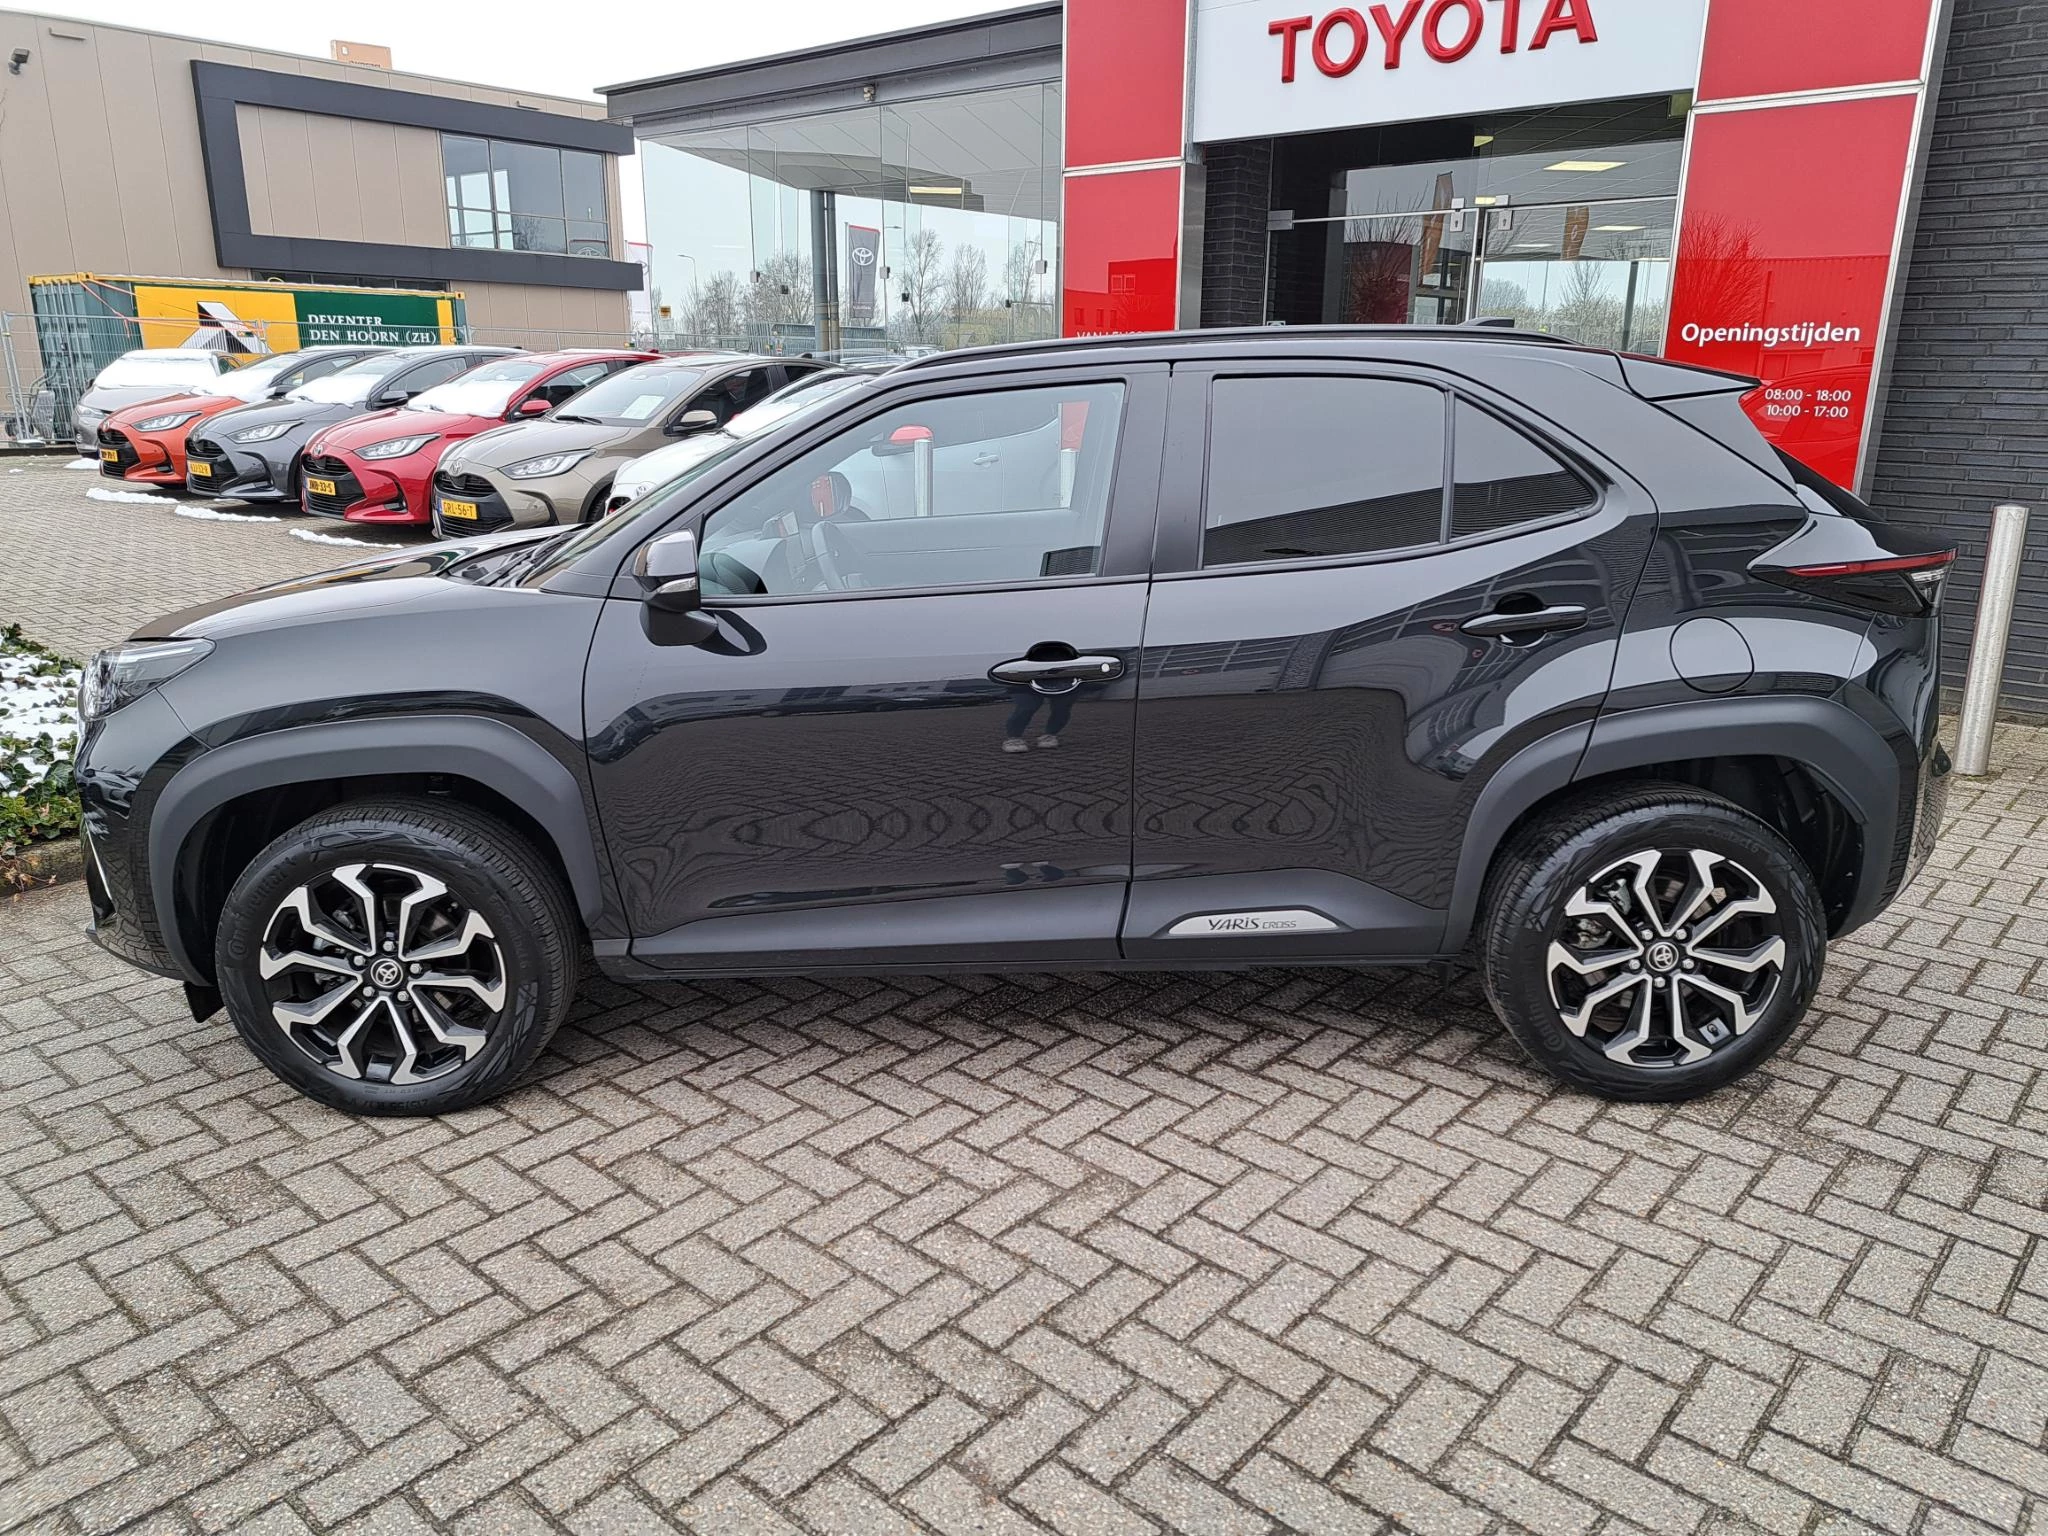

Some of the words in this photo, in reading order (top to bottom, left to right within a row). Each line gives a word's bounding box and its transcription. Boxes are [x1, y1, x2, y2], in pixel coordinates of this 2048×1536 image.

[1268, 0, 1598, 83] TOYOTA
[307, 314, 382, 326] DEVENTER
[309, 330, 340, 341] DEN
[347, 331, 399, 343] HOORN
[405, 331, 436, 344] (ZH)
[1681, 322, 1860, 347] Openingstijden
[1764, 388, 1803, 401] 08:00
[1816, 389, 1851, 402] 18:00
[1766, 404, 1800, 416] 10:00
[1814, 405, 1848, 418] 17:00
[1262, 920, 1297, 930] CROSS
